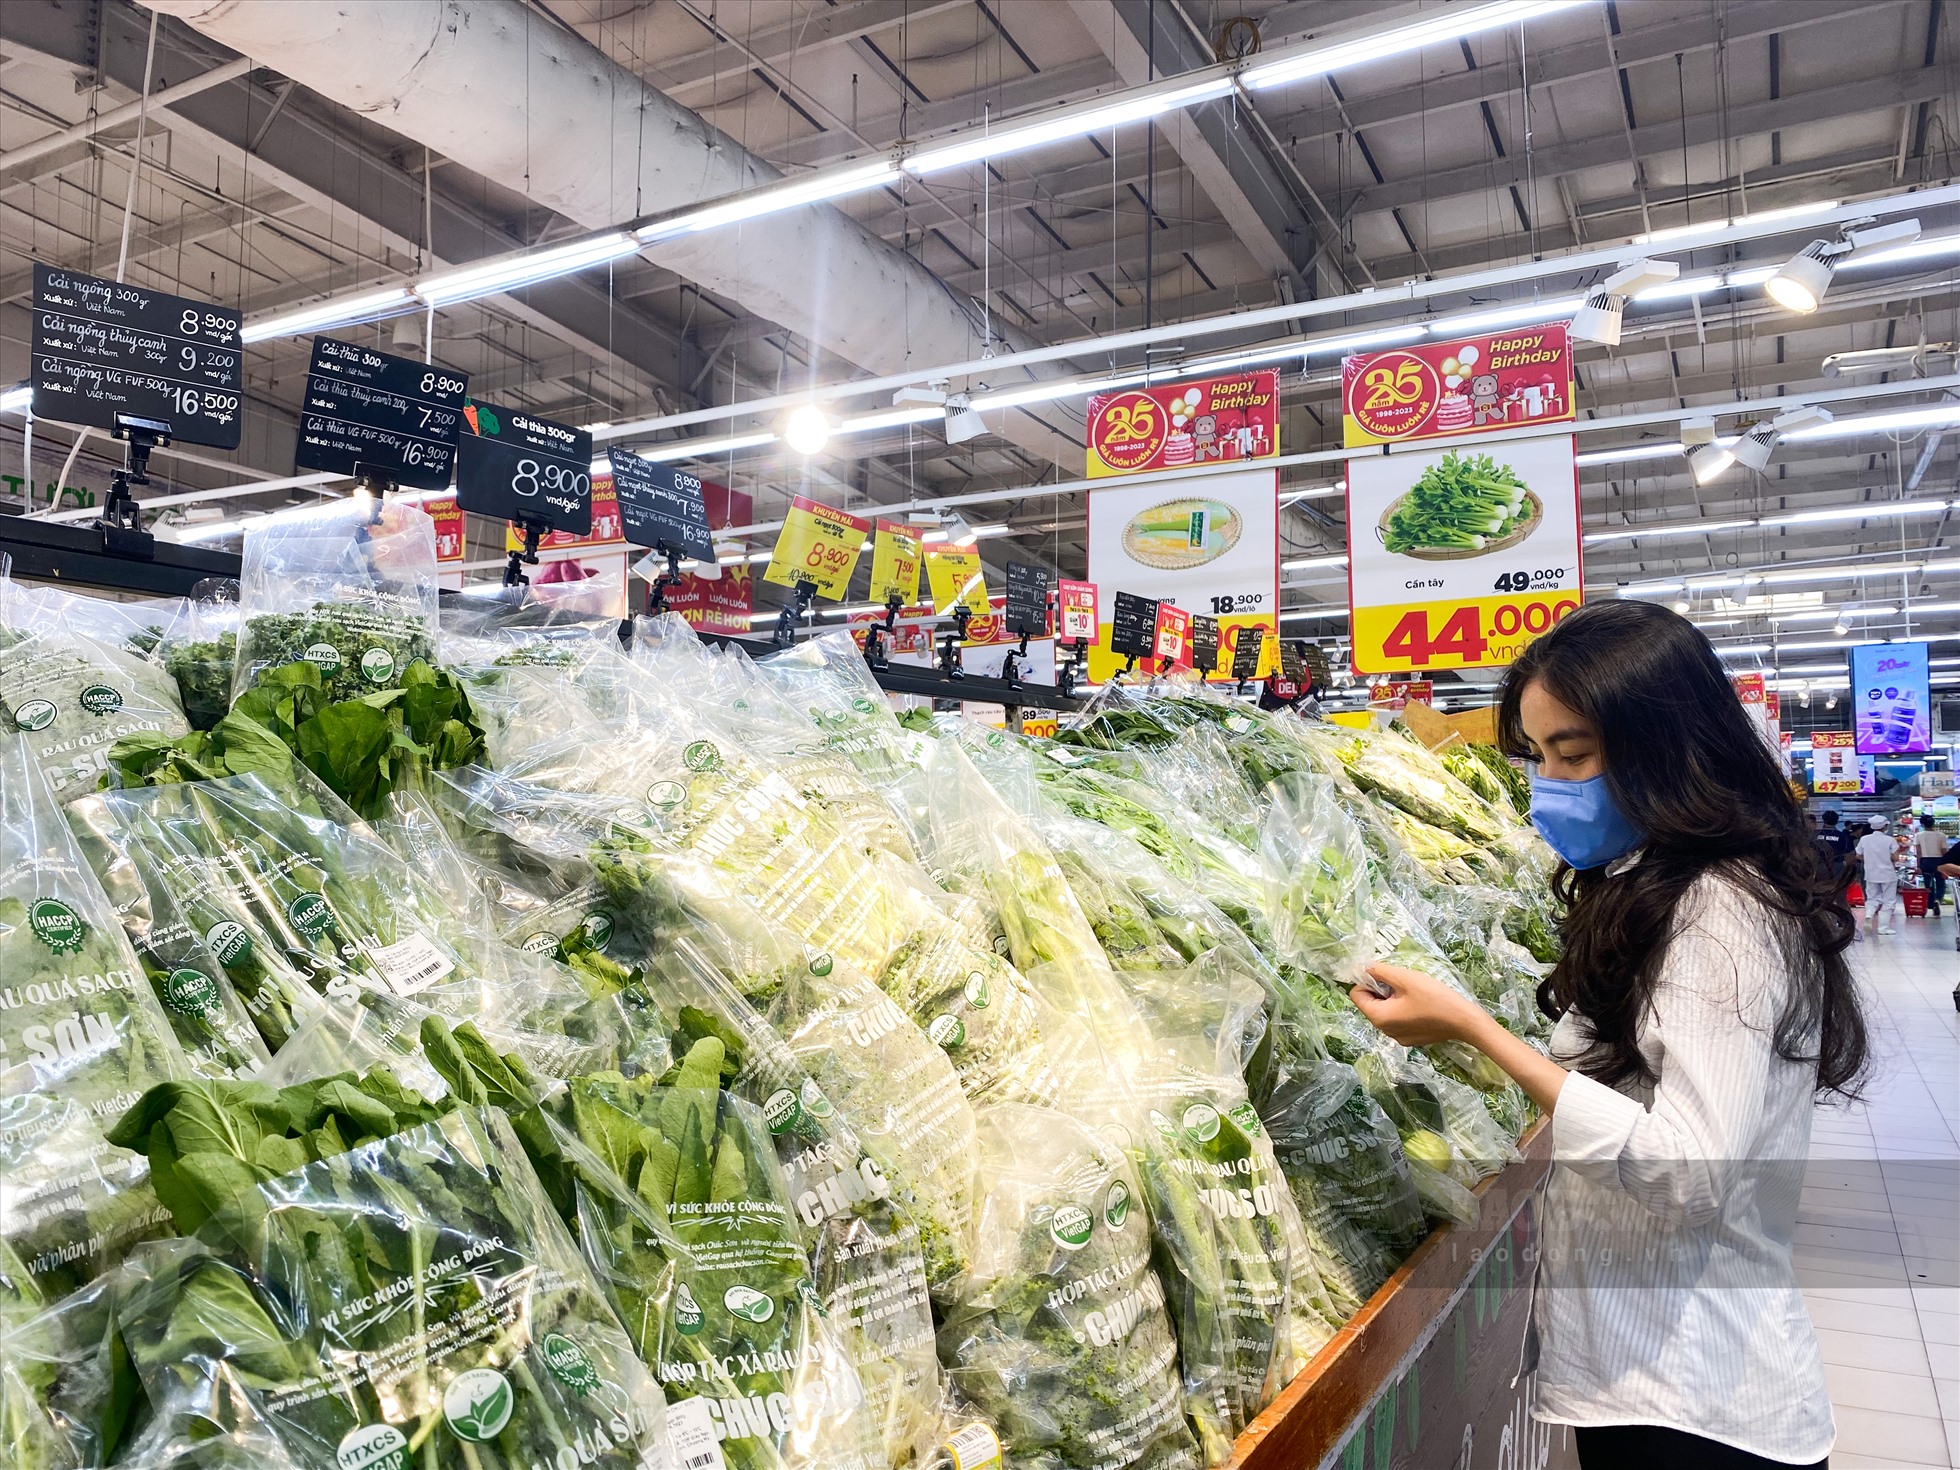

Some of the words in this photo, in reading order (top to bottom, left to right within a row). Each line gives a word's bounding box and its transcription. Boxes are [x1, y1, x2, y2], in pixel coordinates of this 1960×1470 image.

[48, 273, 69, 289] Cải
[104, 305, 126, 316] Nam
[43, 315, 65, 331] Cải
[180, 309, 237, 335] 8.900
[99, 348, 118, 358] Nam
[1490, 334, 1544, 353] Happy
[42, 359, 62, 374] Cải
[179, 347, 234, 371] 9.200
[1490, 348, 1561, 369] Birthday
[420, 373, 464, 393] 8.900
[1210, 379, 1255, 396] Happy
[1364, 359, 1423, 410] 25
[105, 393, 127, 402] Nam
[172, 387, 238, 415] 16.500
[1210, 393, 1270, 411] Birthday
[1371, 400, 1391, 408] năm
[418, 406, 455, 428] 7.500
[1104, 398, 1156, 444] 25
[1376, 407, 1413, 418] 1998-2023
[512, 416, 528, 430] Cải
[1370, 421, 1396, 434] LUÔN
[1396, 418, 1421, 433] LUÔN
[402, 440, 448, 465] 16.900
[1109, 454, 1130, 466] LUÔN
[1130, 450, 1152, 466] LUÔN
[512, 459, 590, 497] 8.900
[807, 542, 849, 566] 8.900
[1494, 568, 1565, 592] 49.000
[1530, 581, 1559, 591] vnd/kg
[1210, 593, 1262, 614] 18.900
[307, 650, 337, 659] HTXCS
[38, 915, 73, 928] HACCP
[294, 900, 325, 925] HACCP
[219, 933, 248, 965] VietGAP
[174, 977, 207, 999] HACCP
[931, 1016, 953, 1041] HTXCS
[764, 1093, 793, 1117] HTXCS
[768, 1105, 797, 1130] VietGAP
[666, 1202, 677, 1214] VÌ
[680, 1202, 702, 1213] SỨC
[705, 1199, 735, 1213] KHỎE
[738, 1200, 764, 1213] CỘNG
[1061, 1219, 1091, 1238] VietGAP
[342, 1296, 373, 1320] SỨC
[419, 1255, 461, 1283] CỘNG
[462, 1235, 504, 1260] ĐỒNG
[340, 1431, 396, 1468] HTXCS
